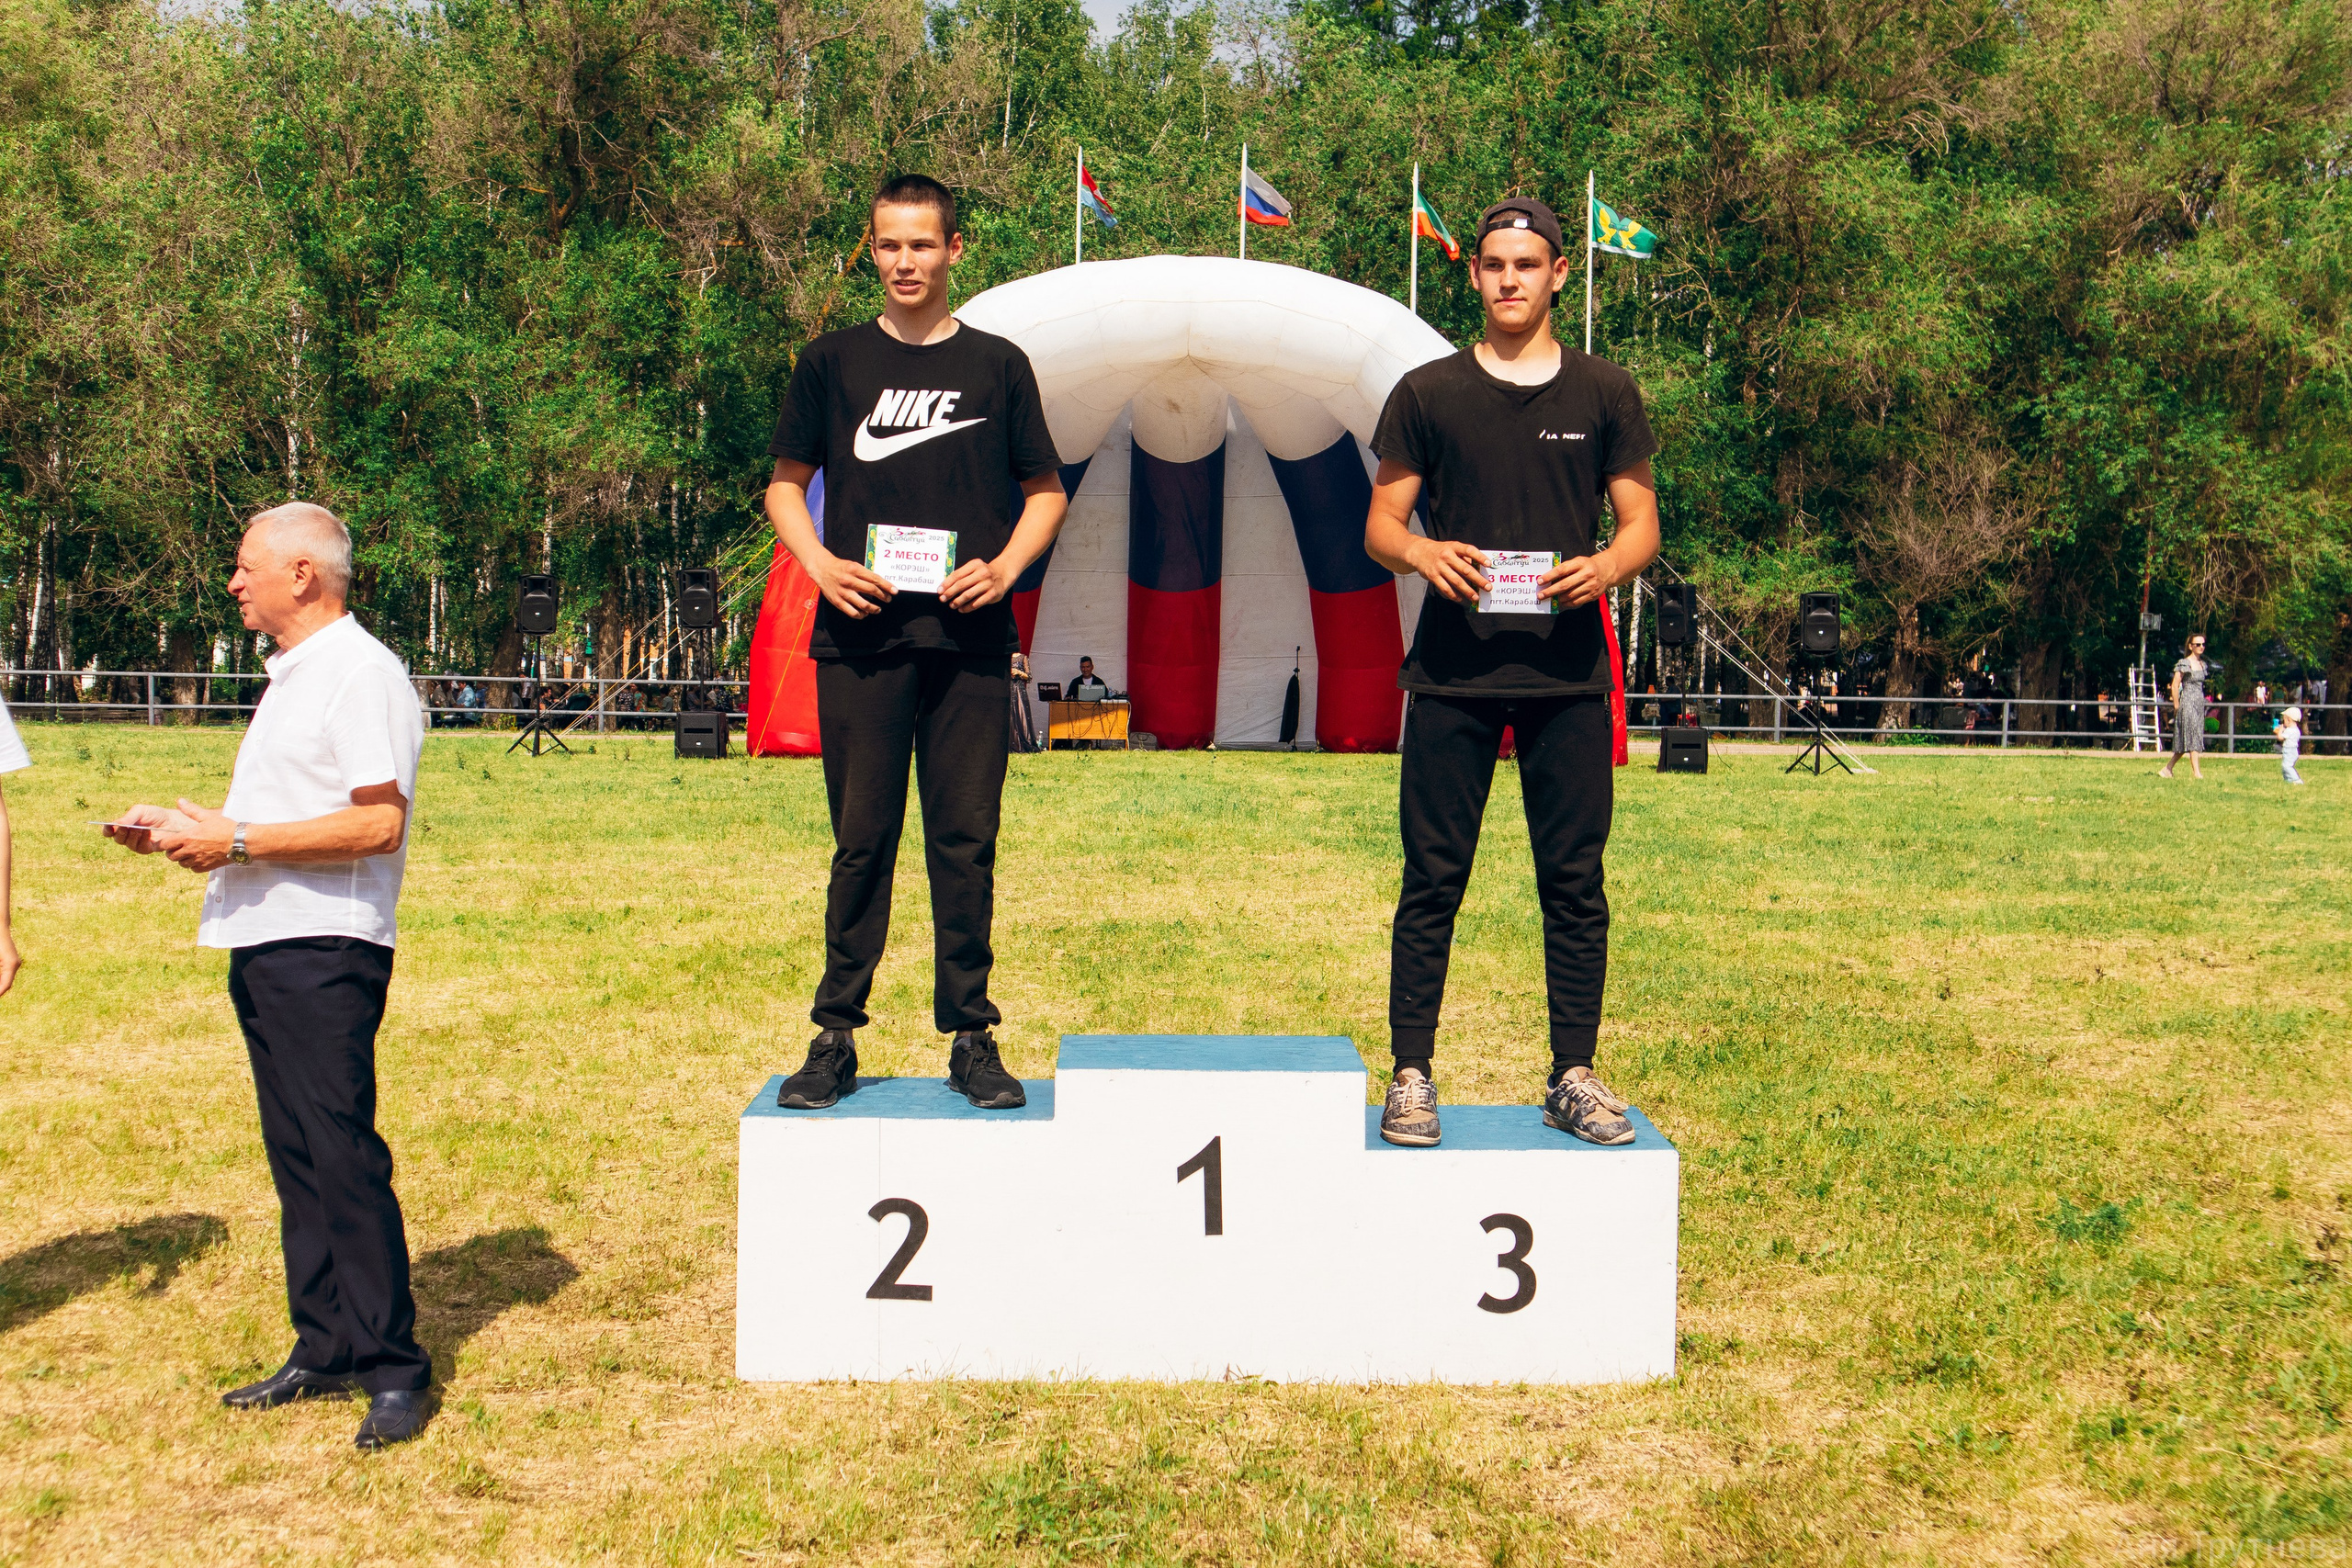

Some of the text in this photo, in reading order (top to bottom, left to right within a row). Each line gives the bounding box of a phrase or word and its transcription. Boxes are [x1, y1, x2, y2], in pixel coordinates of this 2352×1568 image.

[868, 389, 962, 427] NIKE
[884, 549, 939, 562] 2 МЕСТО
[884, 574, 934, 584] пгт.Карабаш
[1488, 574, 1495, 583] 3
[1489, 598, 1542, 606] пгт.Карабаш
[1177, 1136, 1223, 1235] 1
[865, 1198, 933, 1302] 2
[1476, 1213, 1537, 1314] 3
